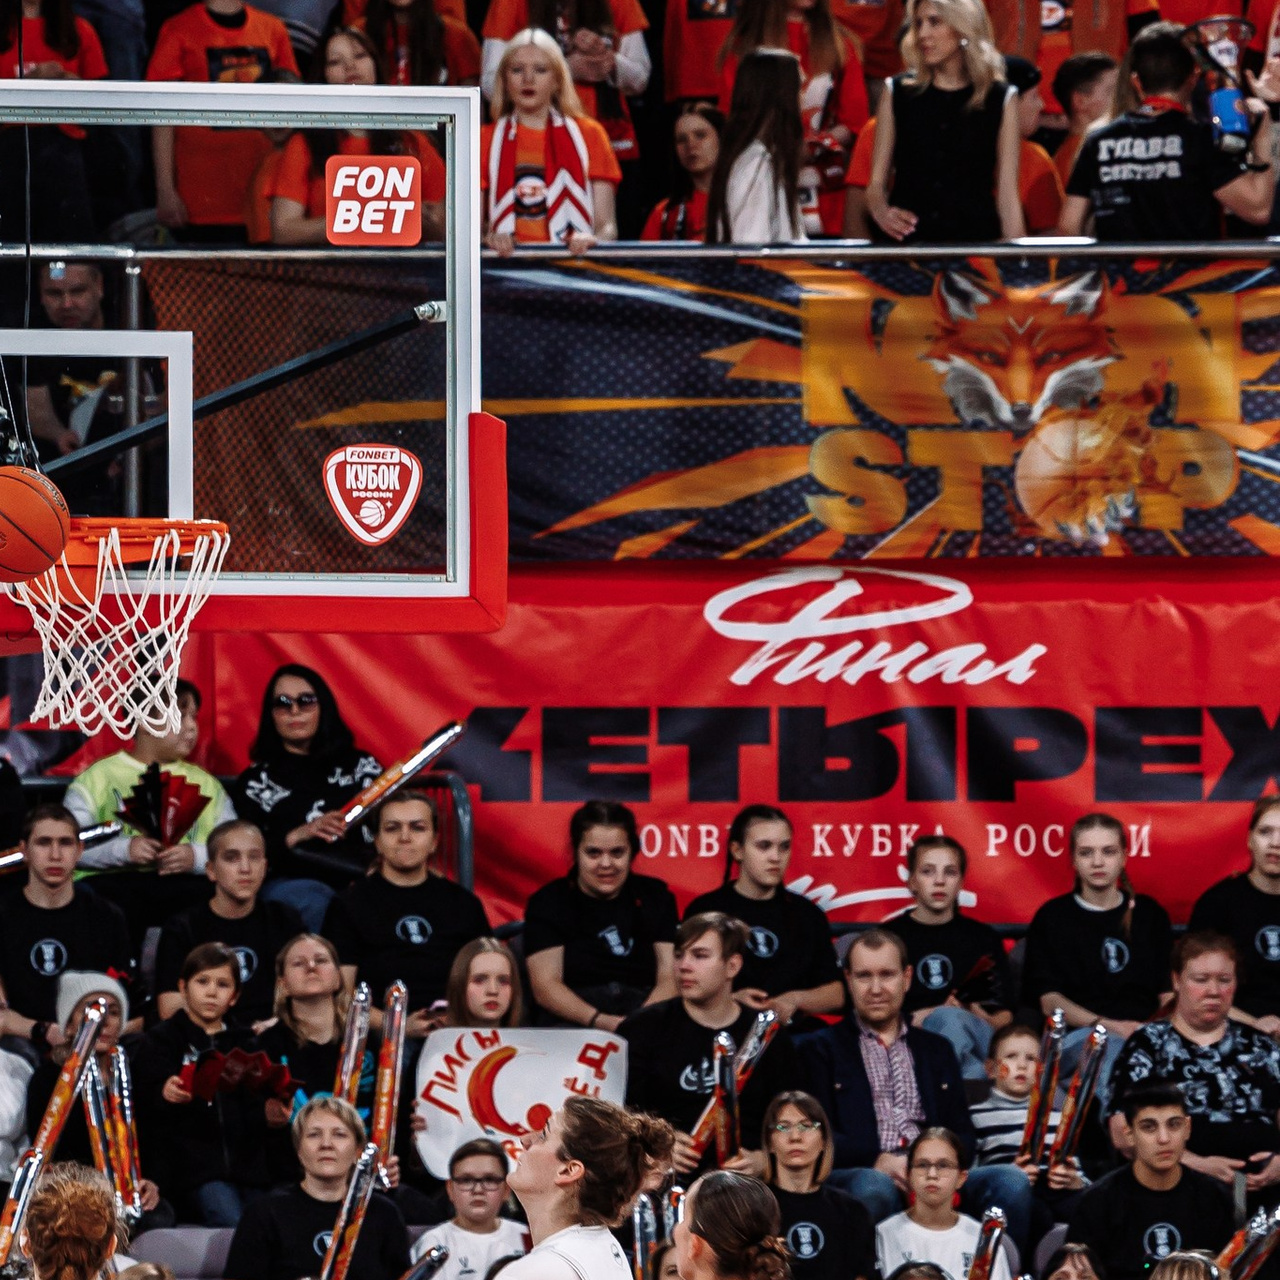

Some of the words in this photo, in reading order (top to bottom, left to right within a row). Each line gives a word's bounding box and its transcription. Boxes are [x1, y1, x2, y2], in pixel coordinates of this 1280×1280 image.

[332, 166, 415, 198] FON
[332, 200, 415, 234] BET
[349, 450, 397, 460] FONBET
[345, 463, 400, 491] КУБОК
[704, 565, 1048, 687] Финал
